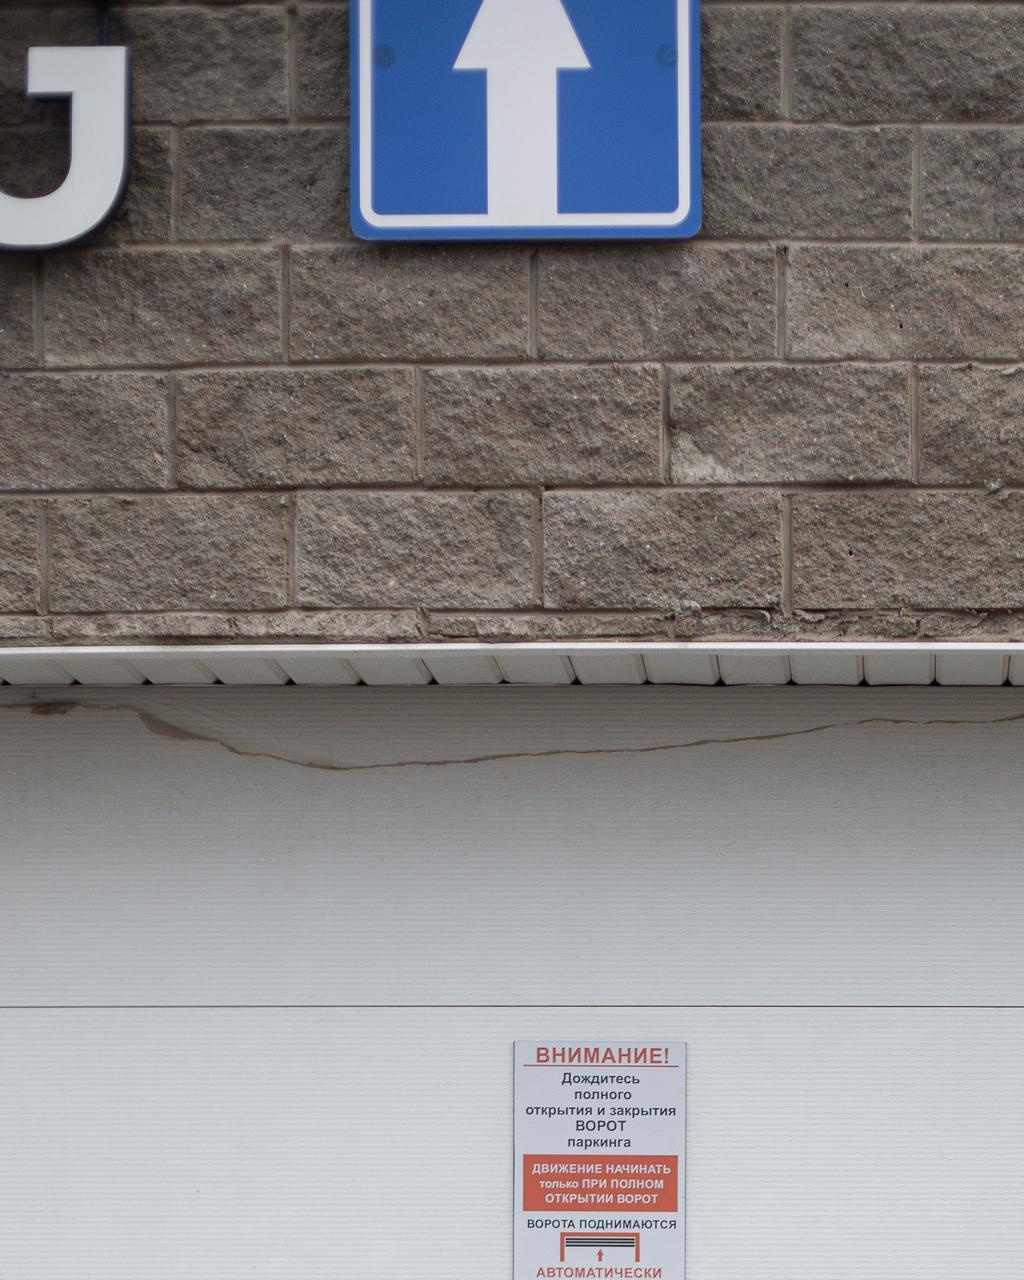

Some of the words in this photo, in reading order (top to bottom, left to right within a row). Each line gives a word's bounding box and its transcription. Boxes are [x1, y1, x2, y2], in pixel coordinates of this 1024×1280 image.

[535, 1046, 670, 1065] ВНИМАНИЕ!
[561, 1072, 641, 1086] Дождитесь
[574, 1090, 632, 1101] полного
[525, 1106, 593, 1117] открытия
[597, 1107, 606, 1116] и
[609, 1107, 677, 1118] закрытия
[575, 1120, 627, 1132] ВОРОТ
[567, 1138, 632, 1149] паркинга
[531, 1163, 602, 1175] ДВИЖЕНИЕ
[606, 1163, 672, 1175] НАЧИНАТЬ
[538, 1180, 579, 1189] только
[582, 1178, 608, 1189] ПРИ
[611, 1178, 665, 1190] ПОЛНОМ
[544, 1193, 614, 1204] ОТКРЫТИИ
[617, 1193, 659, 1204] ВОРОТ
[527, 1219, 576, 1229] ВОРОТА
[579, 1219, 678, 1231] ПОДНИМАЮТСЯ
[536, 1266, 663, 1280] АВТОМАТИЧЕСКИ
